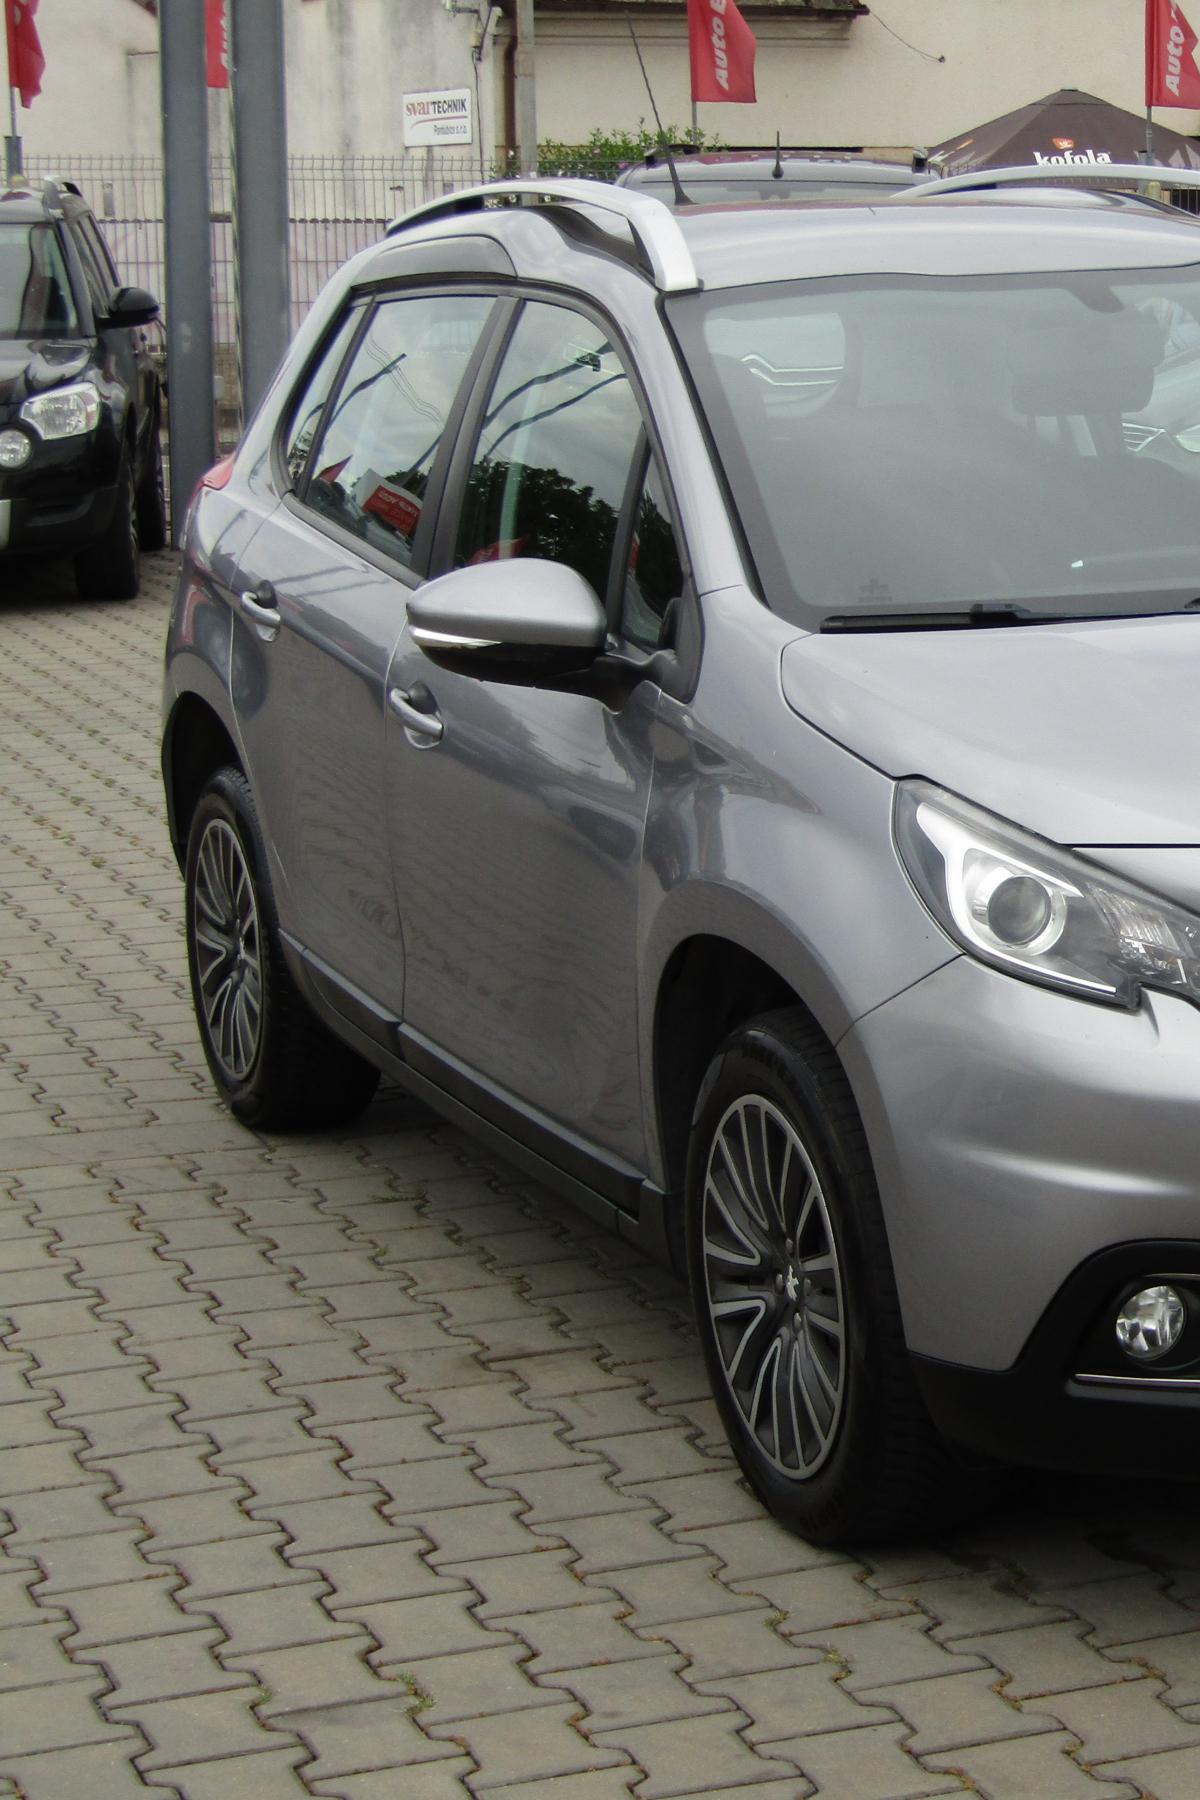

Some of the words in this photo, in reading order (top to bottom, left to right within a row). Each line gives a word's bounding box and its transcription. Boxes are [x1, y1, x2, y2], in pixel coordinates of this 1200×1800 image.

[712, 17, 729, 90] Auto
[1166, 26, 1185, 96] Auto
[1033, 149, 1112, 166] kofola
